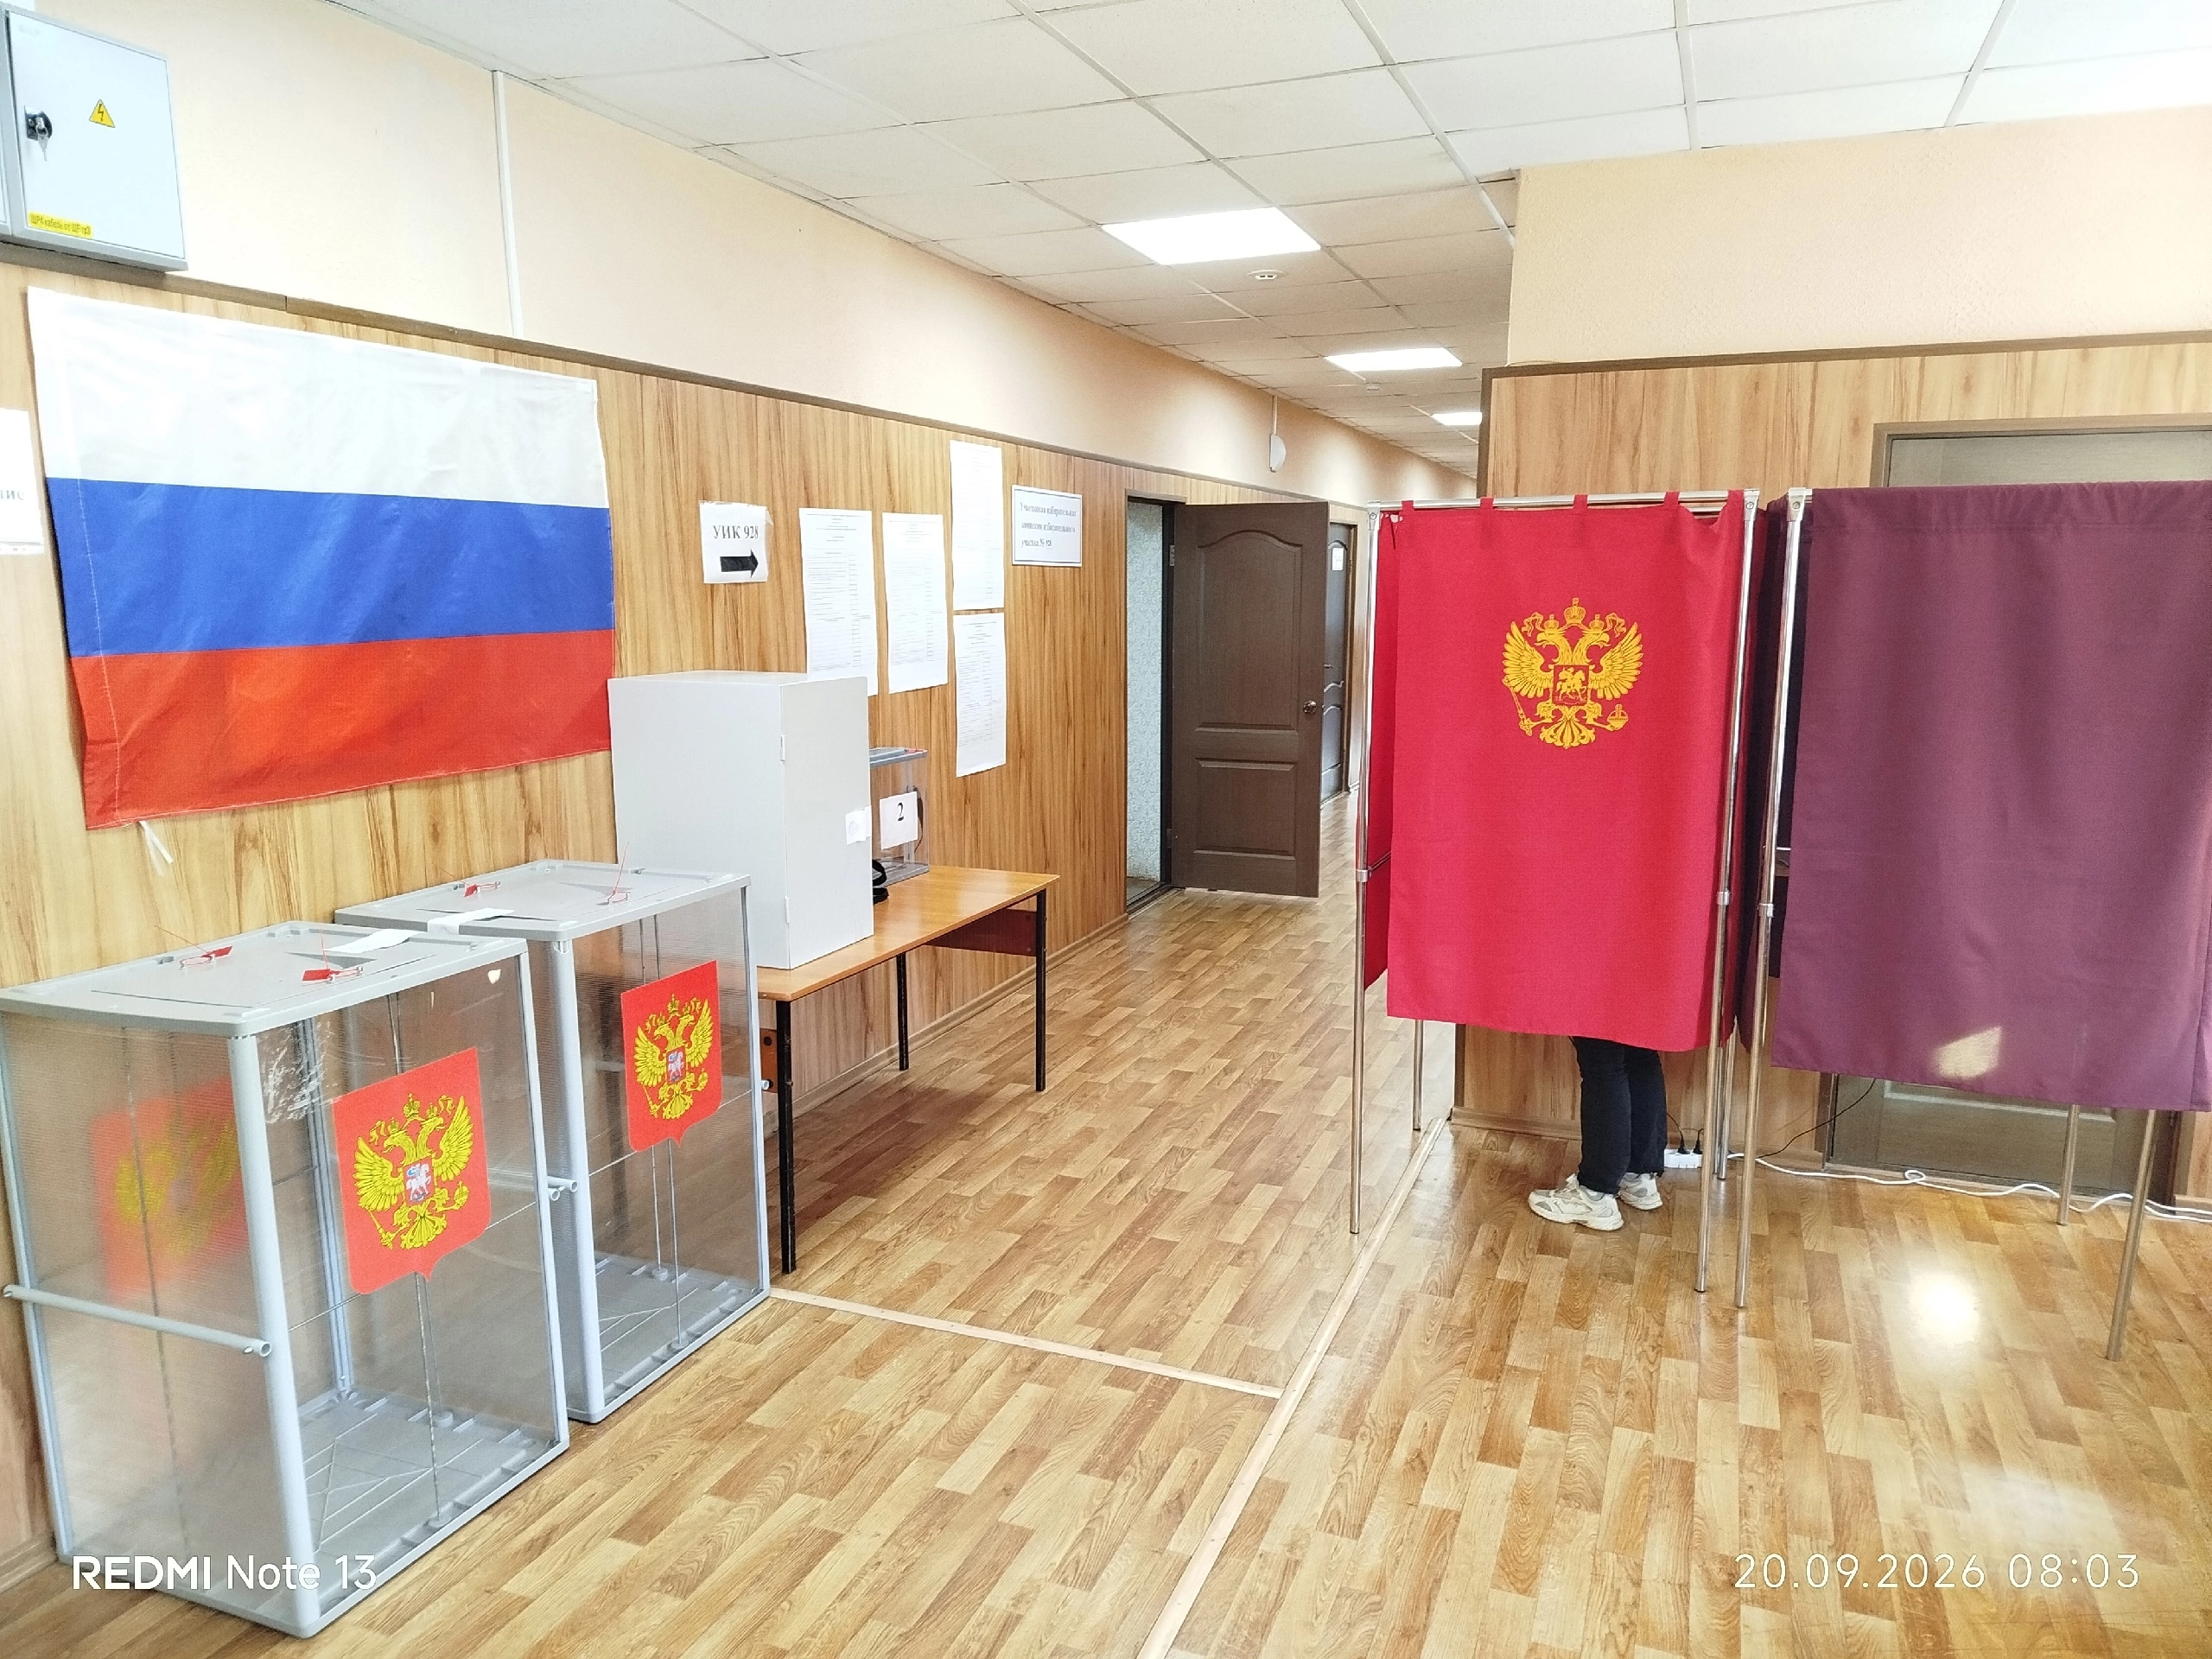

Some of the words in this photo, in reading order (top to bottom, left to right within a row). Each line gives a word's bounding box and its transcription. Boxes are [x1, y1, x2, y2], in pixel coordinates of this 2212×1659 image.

[712, 524, 741, 539] УИК
[744, 524, 760, 539] 928
[897, 802, 905, 822] 2
